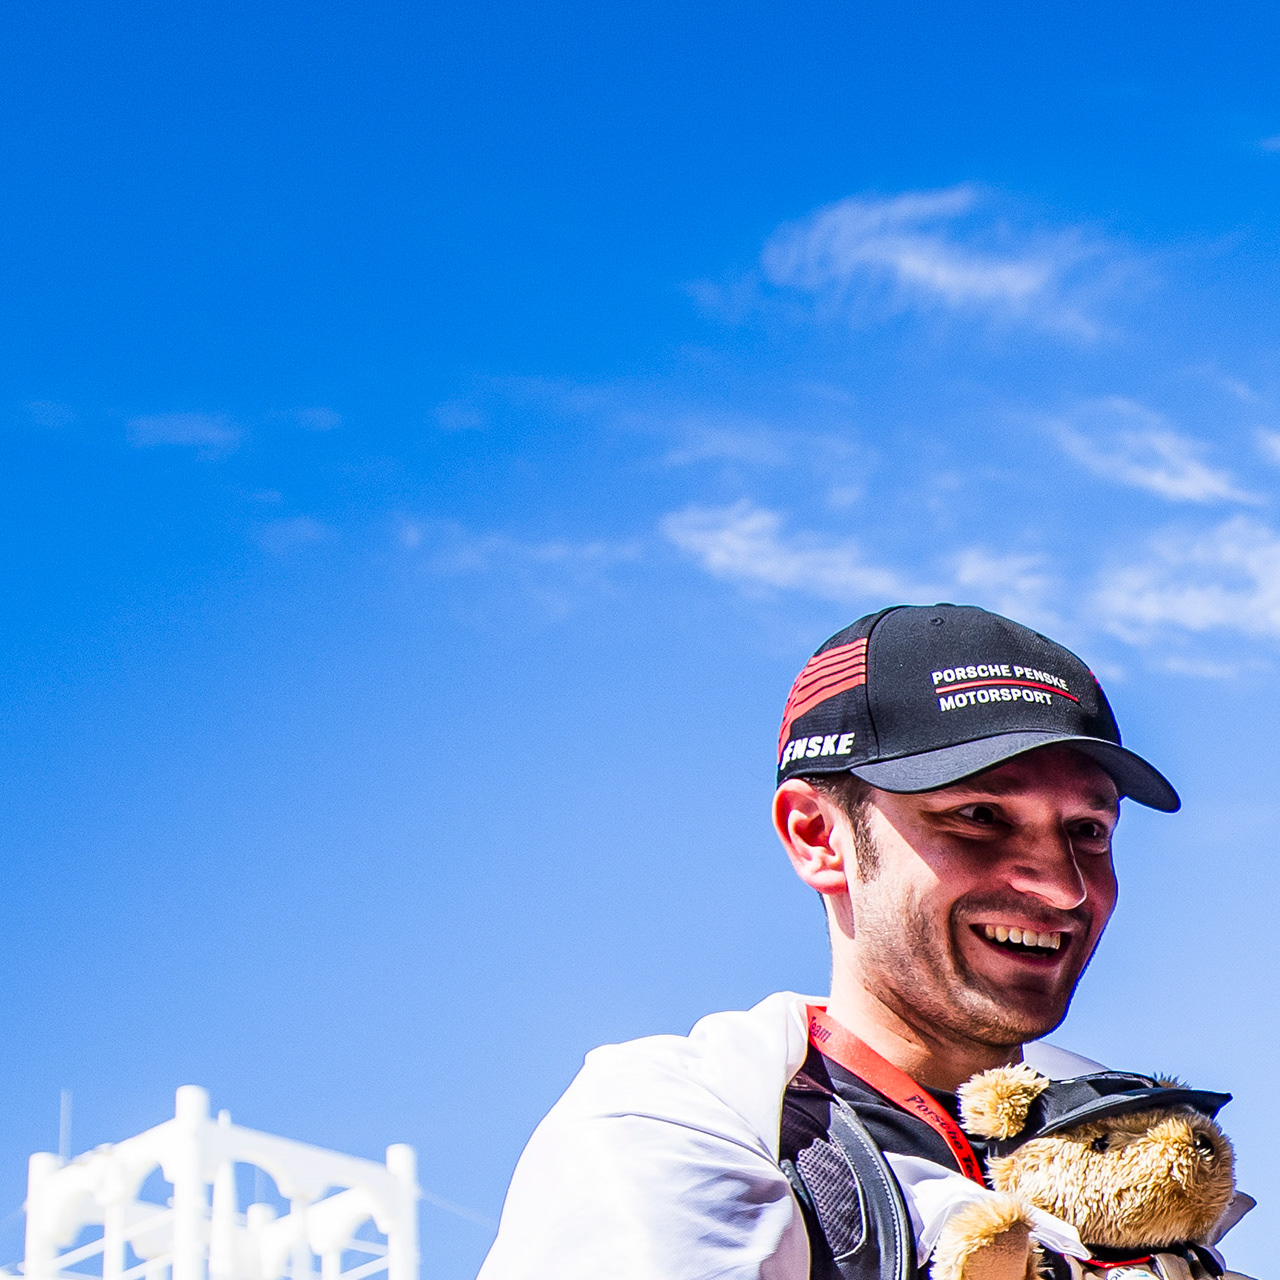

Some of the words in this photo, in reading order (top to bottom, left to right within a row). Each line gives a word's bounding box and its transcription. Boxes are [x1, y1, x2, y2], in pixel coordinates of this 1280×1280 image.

[931, 663, 1012, 685] PORSCHE
[1014, 665, 1070, 692] PENSKE
[938, 688, 1053, 713] MOTORSPORT
[905, 1094, 964, 1150] Porsche
